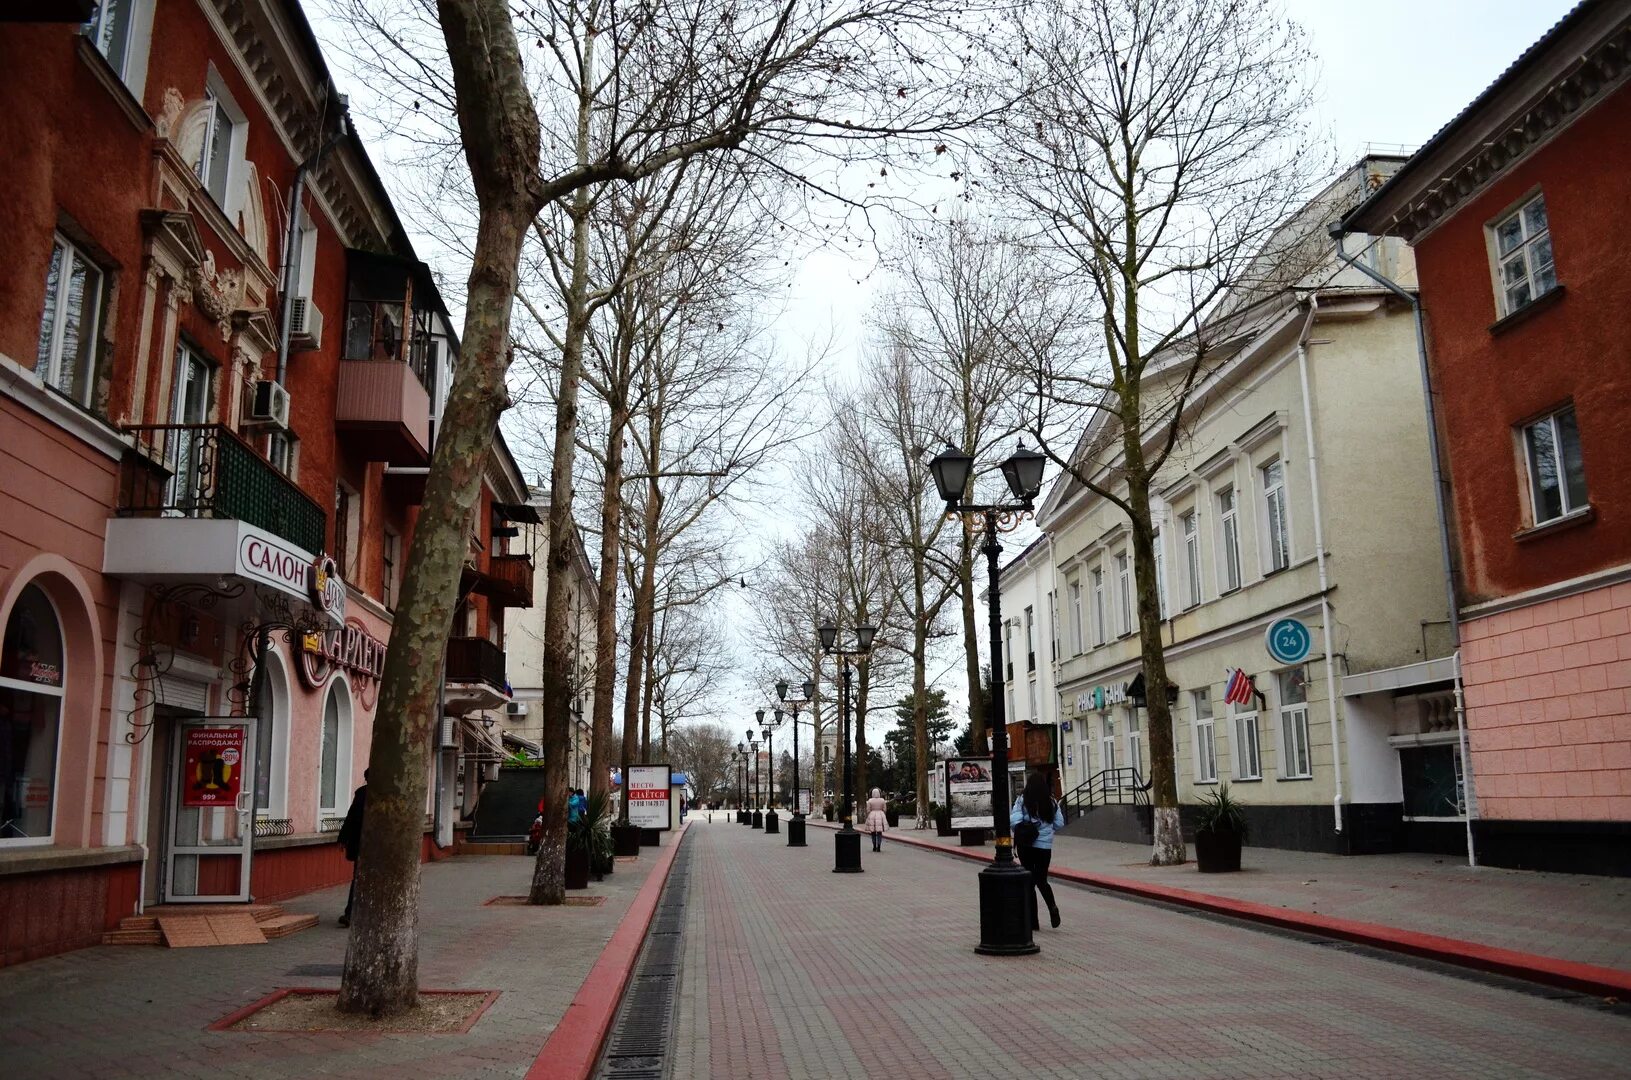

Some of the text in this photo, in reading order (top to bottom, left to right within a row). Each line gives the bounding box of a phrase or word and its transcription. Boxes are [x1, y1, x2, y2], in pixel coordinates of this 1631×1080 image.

[248, 542, 304, 587] САЛОН
[1282, 637, 1297, 647] 24
[1104, 682, 1127, 705] БАНК
[630, 789, 665, 799] СДАЁТСЯ
